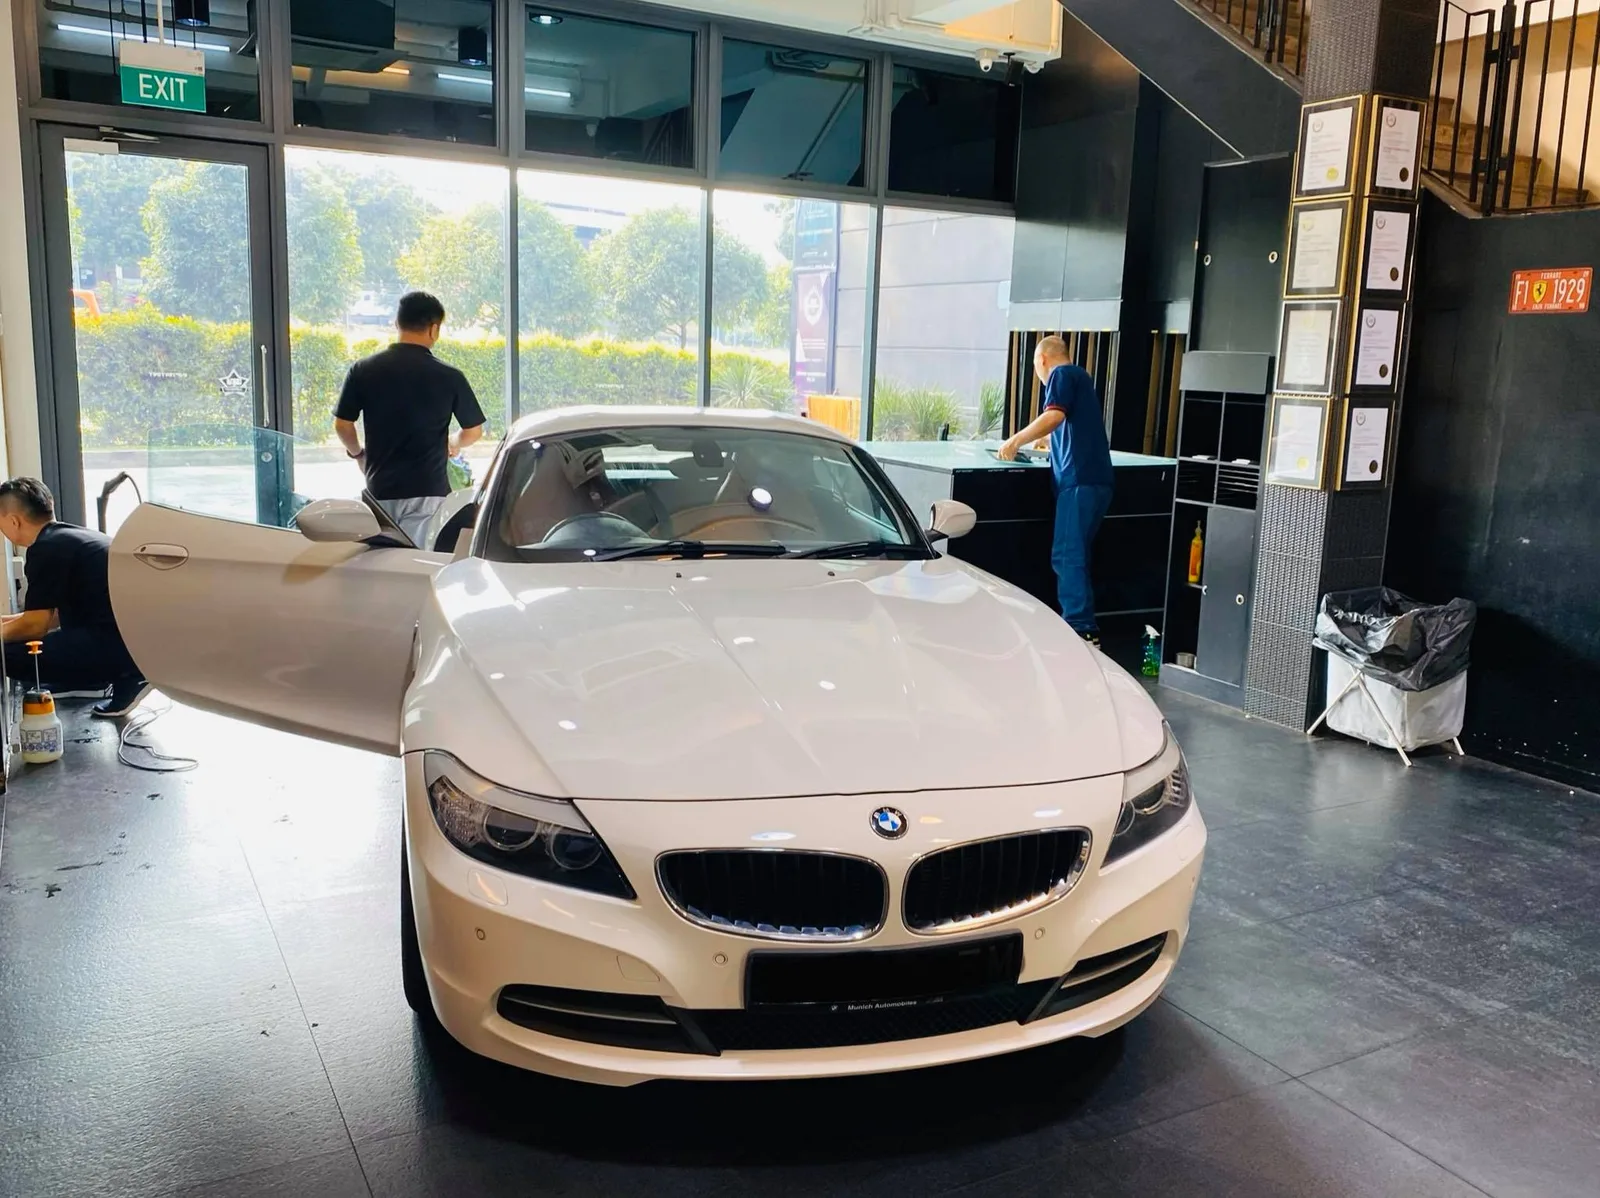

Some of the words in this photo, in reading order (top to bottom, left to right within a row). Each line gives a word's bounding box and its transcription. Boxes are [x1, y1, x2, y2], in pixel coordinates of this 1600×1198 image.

[138, 72, 188, 103] EXIT
[1514, 279, 1530, 306] F1
[1552, 277, 1586, 304] 1929
[847, 1003, 874, 1011] Munich
[874, 1000, 918, 1010] Automobiles
